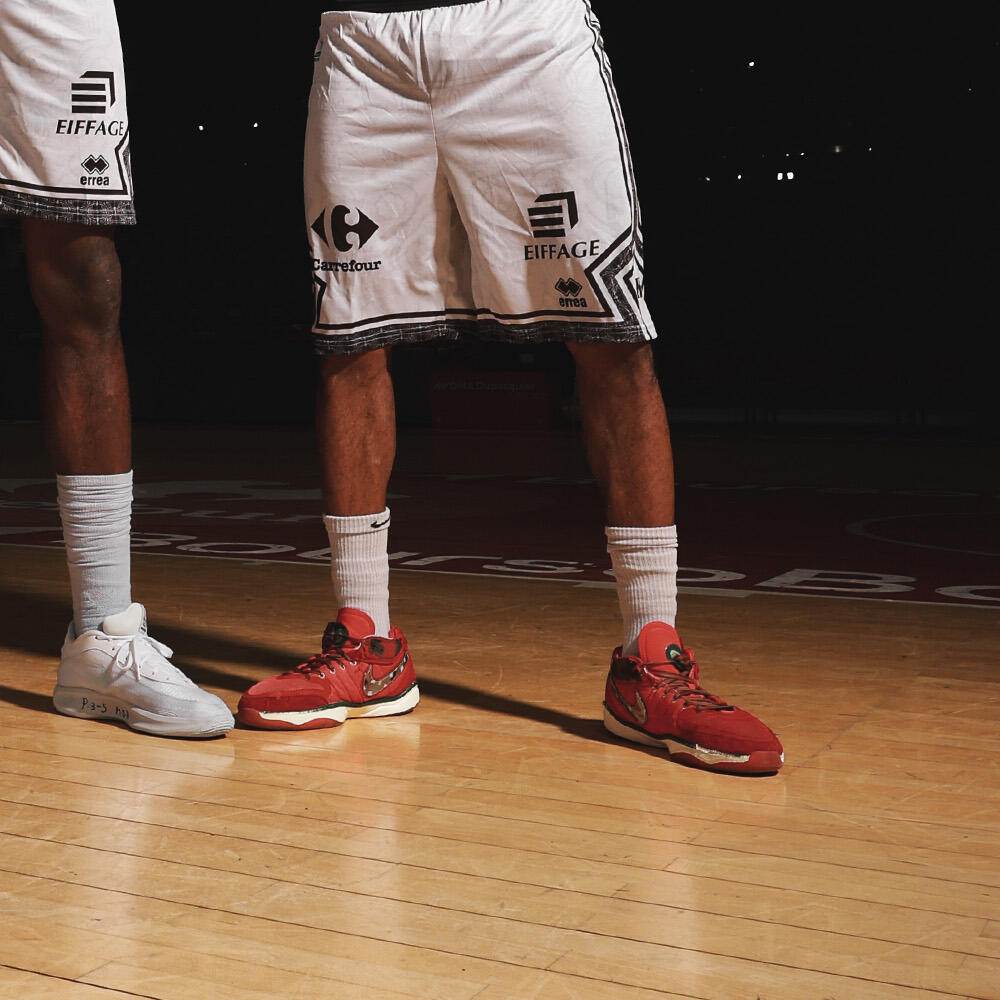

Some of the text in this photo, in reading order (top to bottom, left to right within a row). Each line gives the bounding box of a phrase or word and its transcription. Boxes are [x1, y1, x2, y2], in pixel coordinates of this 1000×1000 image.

[55, 119, 125, 136] EIFFAGE
[79, 175, 110, 186] errea
[524, 239, 601, 261] EIFFAGE
[312, 259, 382, 273] Carrefour
